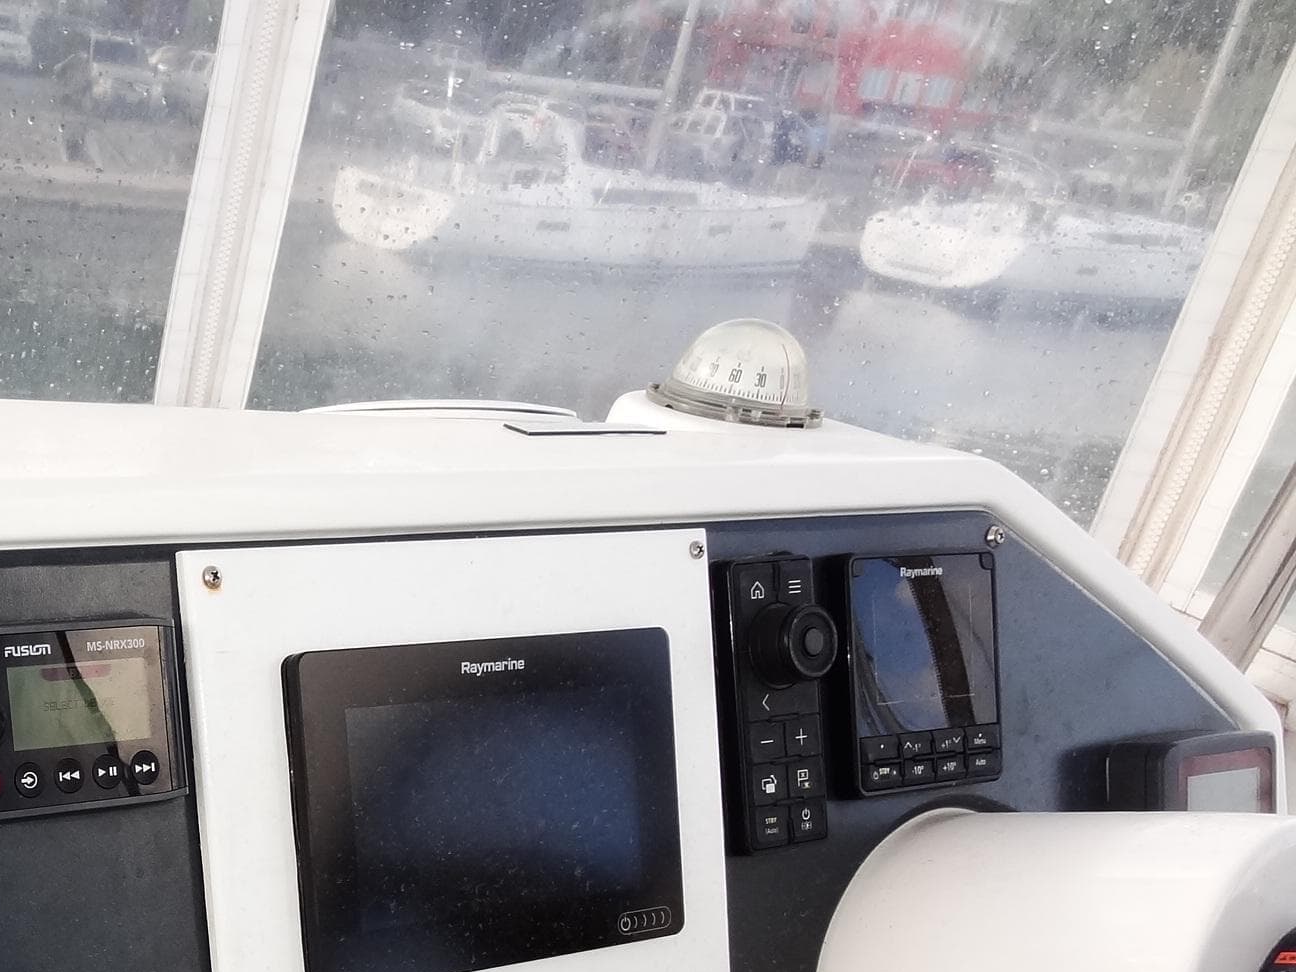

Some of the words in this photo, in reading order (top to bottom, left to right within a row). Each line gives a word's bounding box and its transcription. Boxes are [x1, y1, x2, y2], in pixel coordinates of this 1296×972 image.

[728, 368, 743, 383] 60
[754, 373, 767, 388] 30
[899, 565, 944, 578] Raymarine
[86, 638, 145, 652] MS-NRX300
[460, 657, 525, 676] Raymarine
